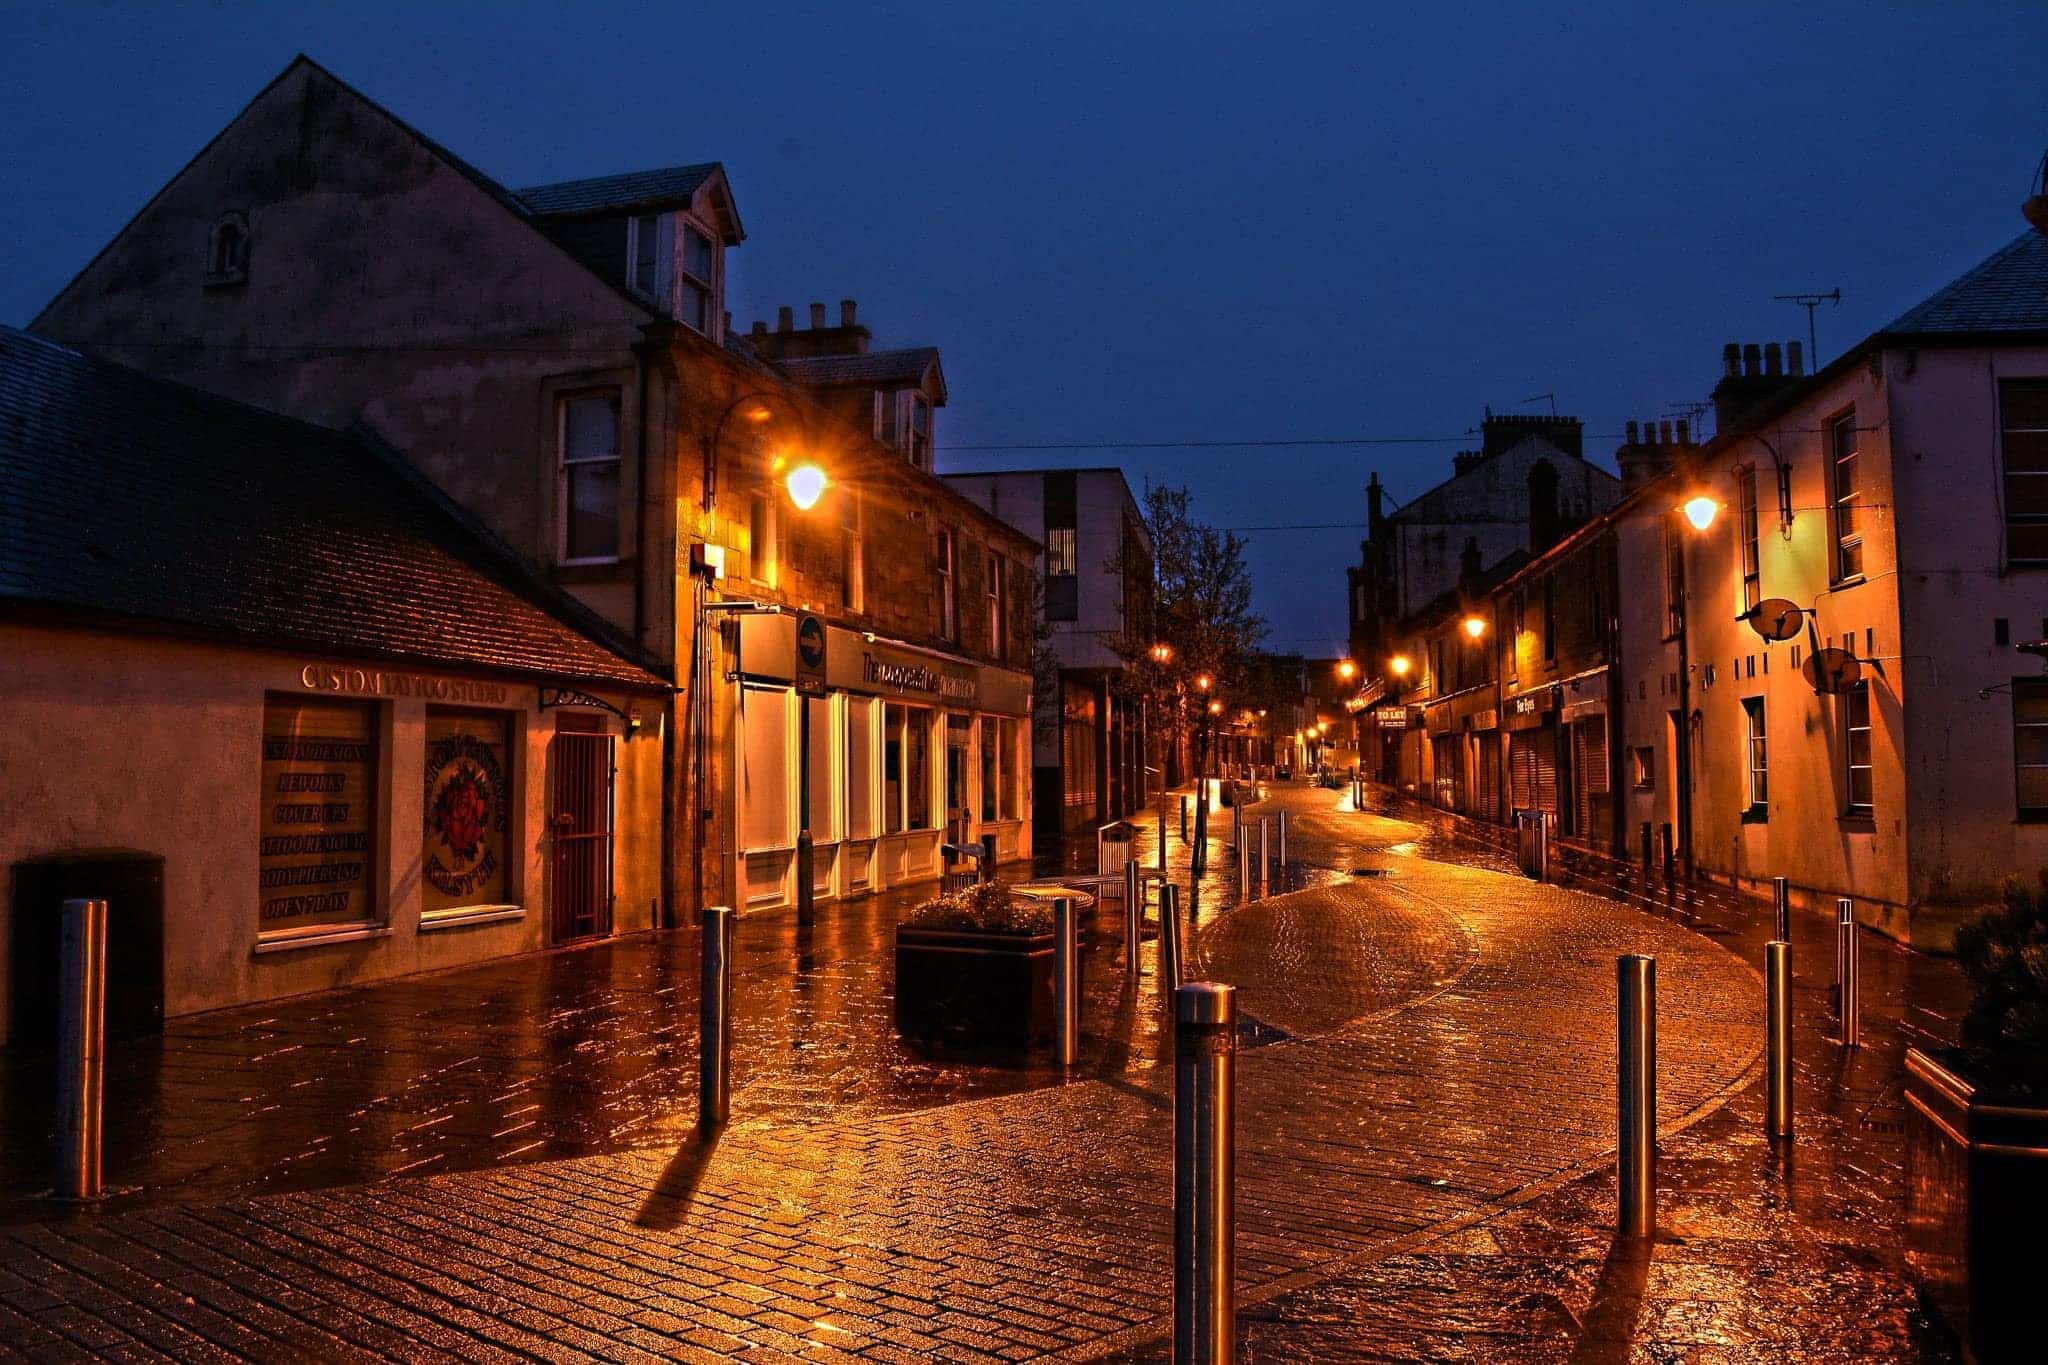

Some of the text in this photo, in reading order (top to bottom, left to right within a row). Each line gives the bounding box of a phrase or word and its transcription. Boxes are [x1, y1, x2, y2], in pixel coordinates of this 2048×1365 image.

[862, 651, 879, 683] The
[301, 663, 507, 704] CUSTOM TATTOO STUDIO
[1377, 711, 1404, 720] TO LET
[311, 742, 368, 761] DESIGNS
[279, 773, 346, 792] REWORKS
[272, 802, 350, 823] COVER UPS
[297, 863, 361, 886] PIERCING
[263, 897, 304, 918] OPEN
[314, 892, 350, 913] DAYS
